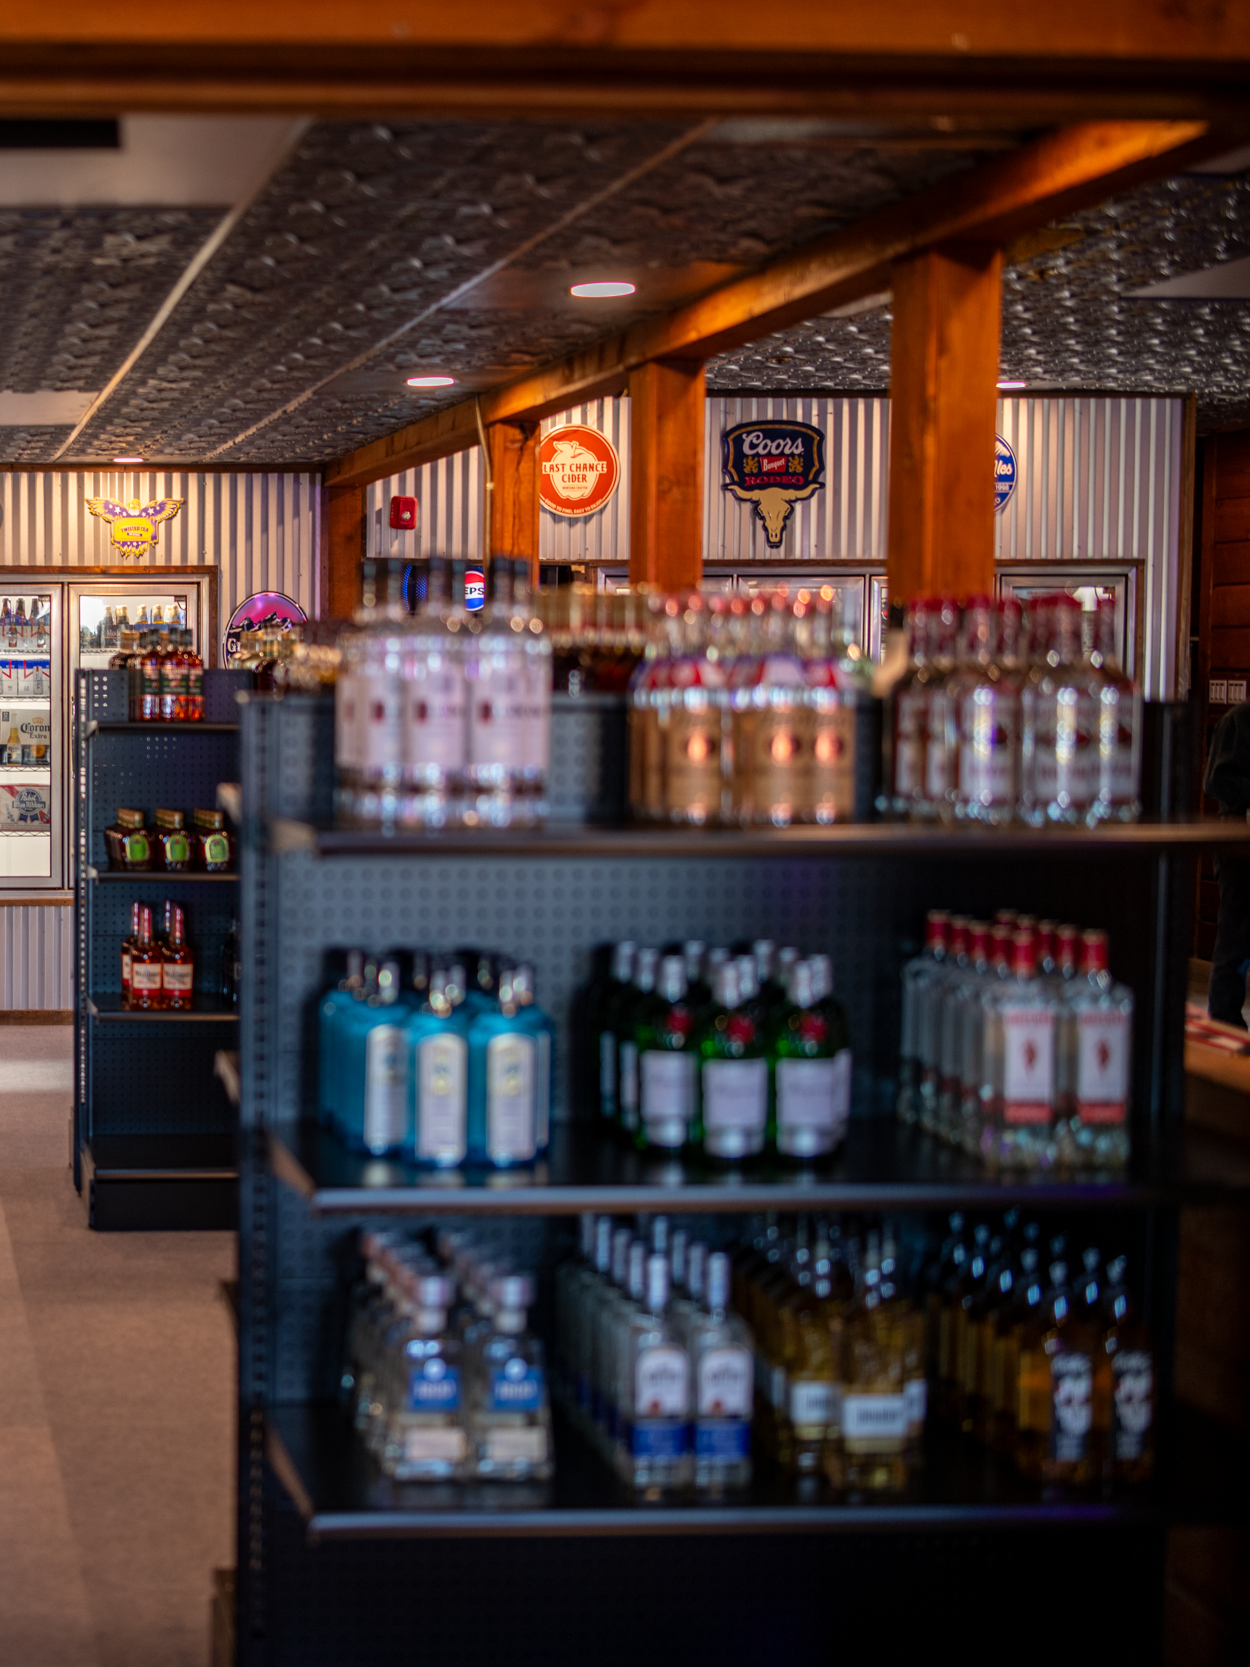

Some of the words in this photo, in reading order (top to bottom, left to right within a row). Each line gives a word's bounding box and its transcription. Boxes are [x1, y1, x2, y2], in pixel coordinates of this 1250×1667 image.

[742, 431, 804, 455] Coors
[543, 463, 566, 473] LAST
[569, 463, 606, 473] CHANCE
[763, 458, 785, 471] Banquet
[561, 474, 587, 483] CIDER
[744, 475, 804, 487] RODEO
[465, 587, 484, 595] EPS
[20, 722, 50, 734] Coron
